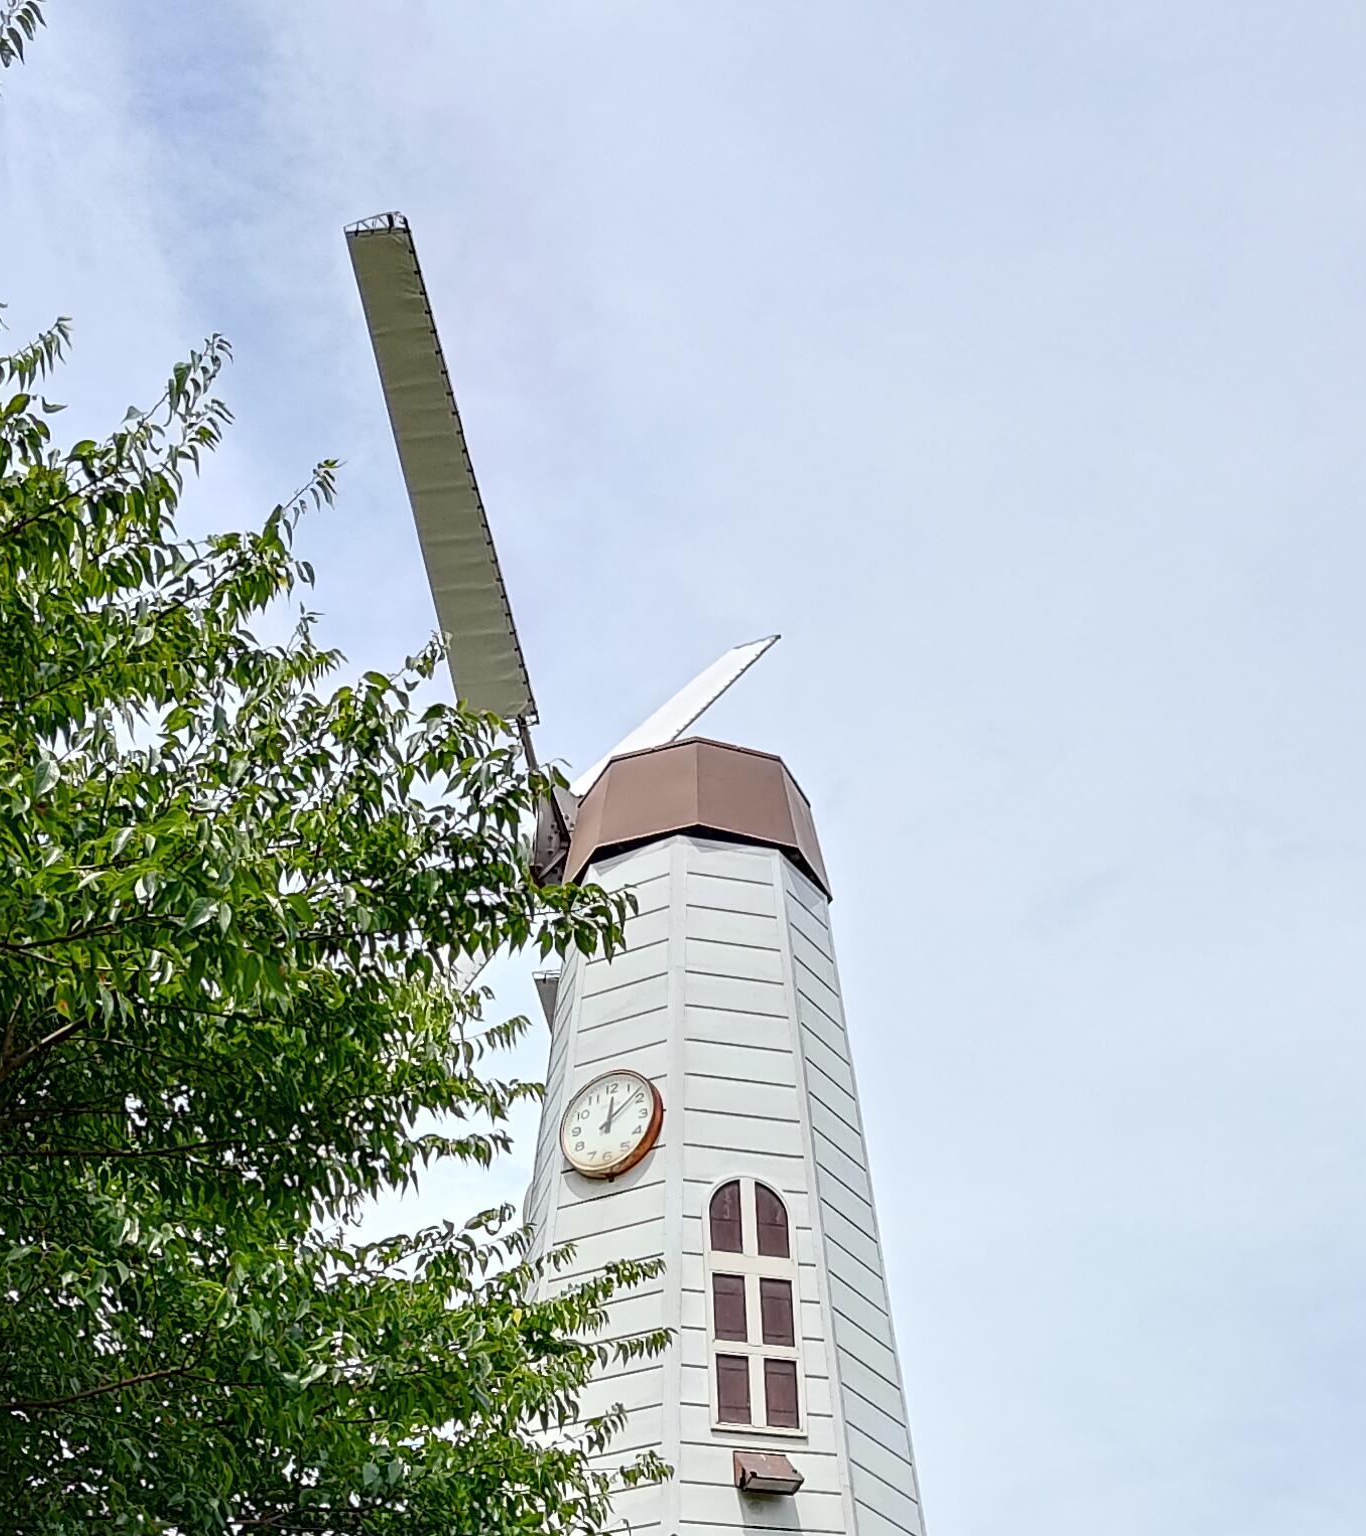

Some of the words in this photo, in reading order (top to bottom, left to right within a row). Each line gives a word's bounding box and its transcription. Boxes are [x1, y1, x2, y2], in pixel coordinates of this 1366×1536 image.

[605, 1083, 619, 1095] 12
[626, 1083, 631, 1093] 1
[588, 1094, 600, 1106] 11
[635, 1092, 645, 1104] 2
[576, 1109, 590, 1121] 10
[638, 1108, 648, 1119] 3
[571, 1126, 582, 1137] 9
[631, 1125, 642, 1135] 4
[575, 1141, 585, 1152] 8
[620, 1141, 631, 1152] 5
[587, 1151, 597, 1162] 7
[602, 1151, 613, 1161] 6
